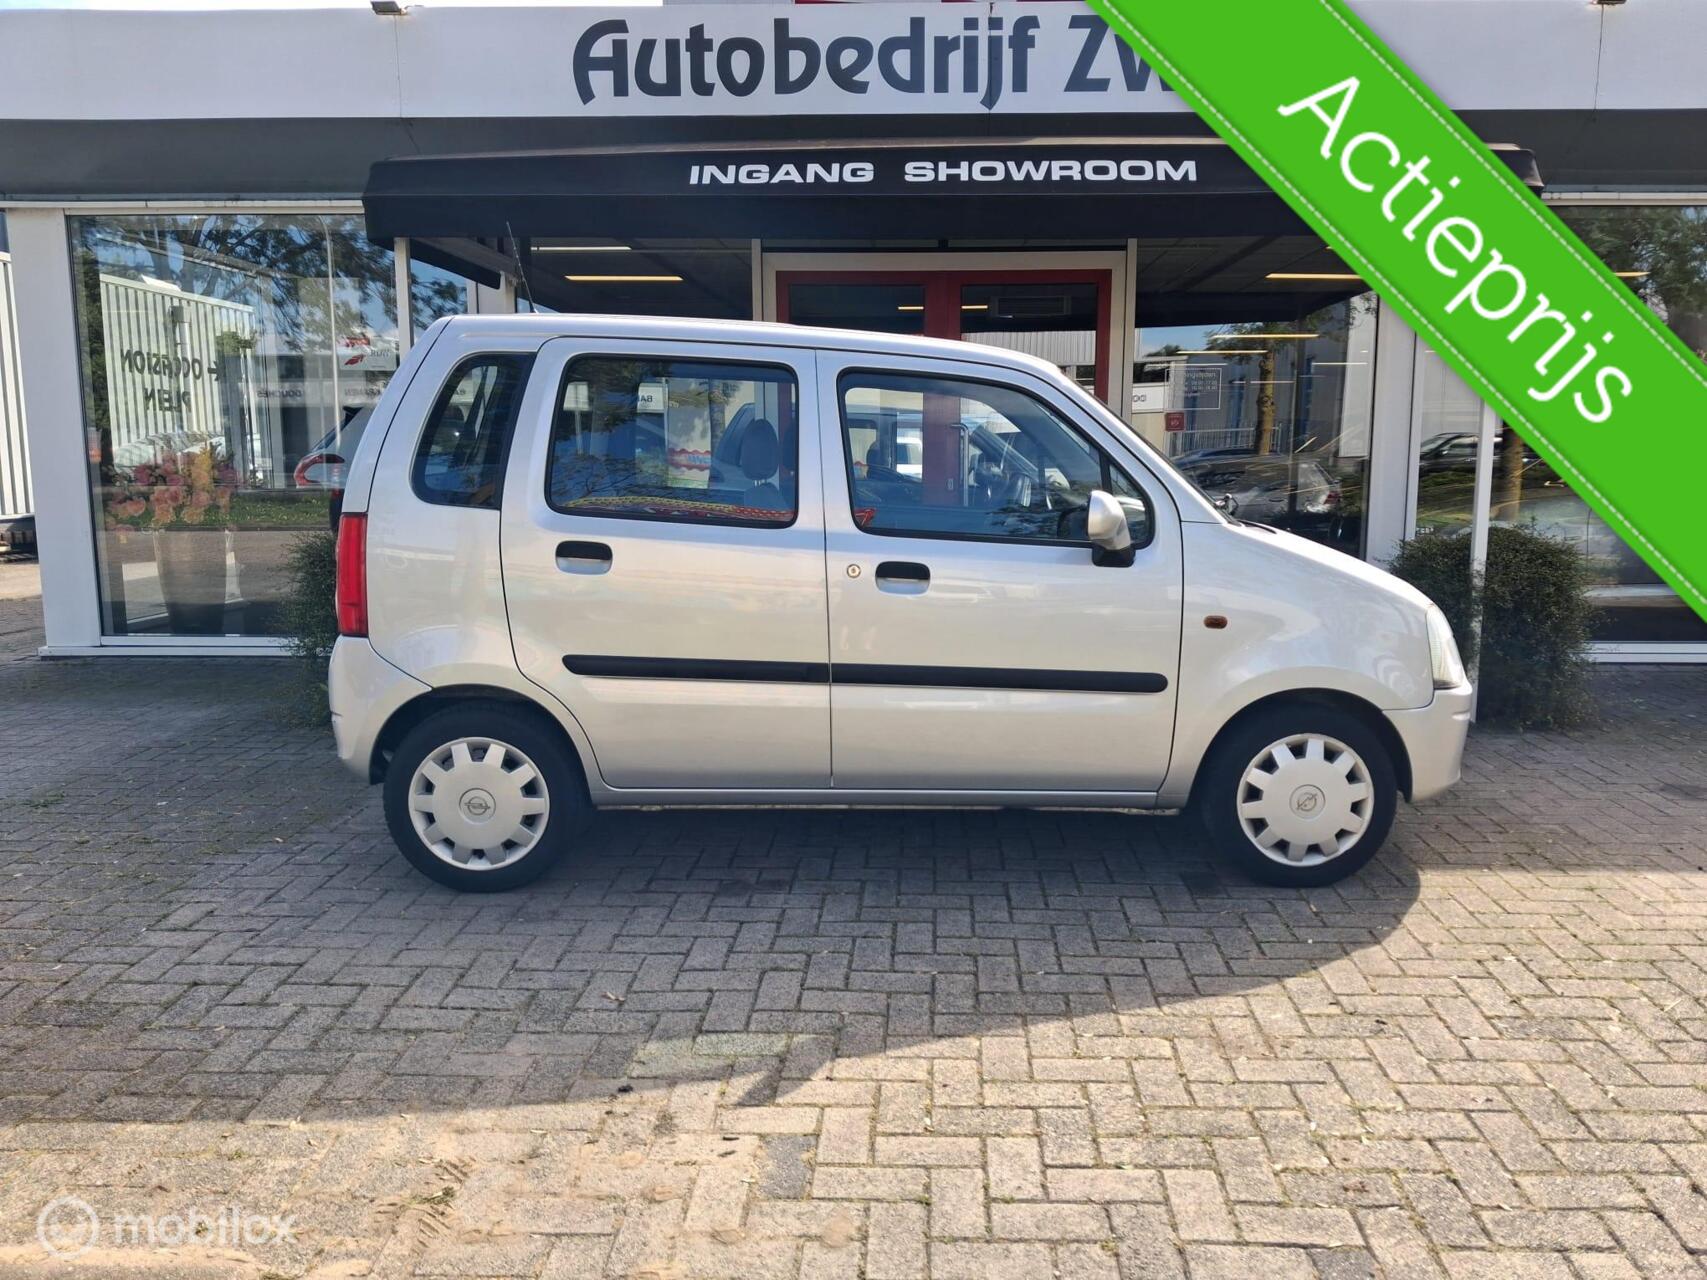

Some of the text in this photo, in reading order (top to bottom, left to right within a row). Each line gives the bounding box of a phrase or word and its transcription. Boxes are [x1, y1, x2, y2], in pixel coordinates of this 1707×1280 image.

[573, 15, 1041, 111] Autobedrijf
[689, 160, 1197, 185] INGANG SHOWROOM
